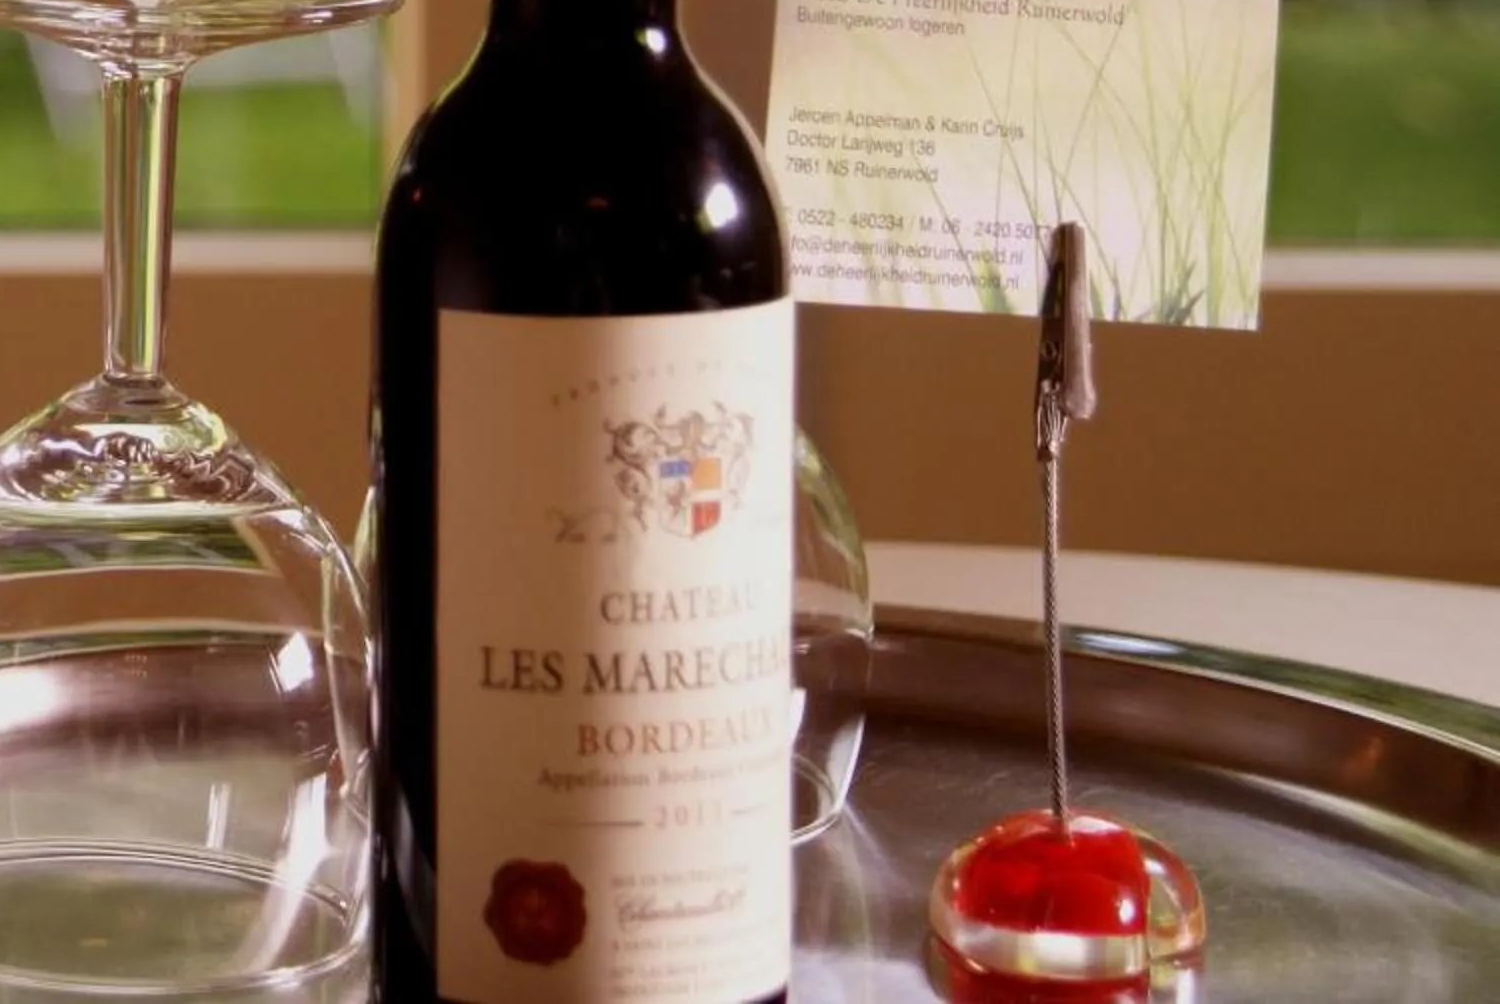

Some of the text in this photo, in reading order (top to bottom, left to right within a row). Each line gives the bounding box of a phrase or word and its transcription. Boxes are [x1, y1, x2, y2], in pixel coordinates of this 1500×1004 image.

[797, 6, 965, 37] Buitengewoon logeren
[788, 106, 841, 125] Jeroen
[925, 115, 935, 132] &
[787, 129, 836, 150] Doctor
[826, 158, 849, 177] NS
[479, 645, 565, 694] LES
